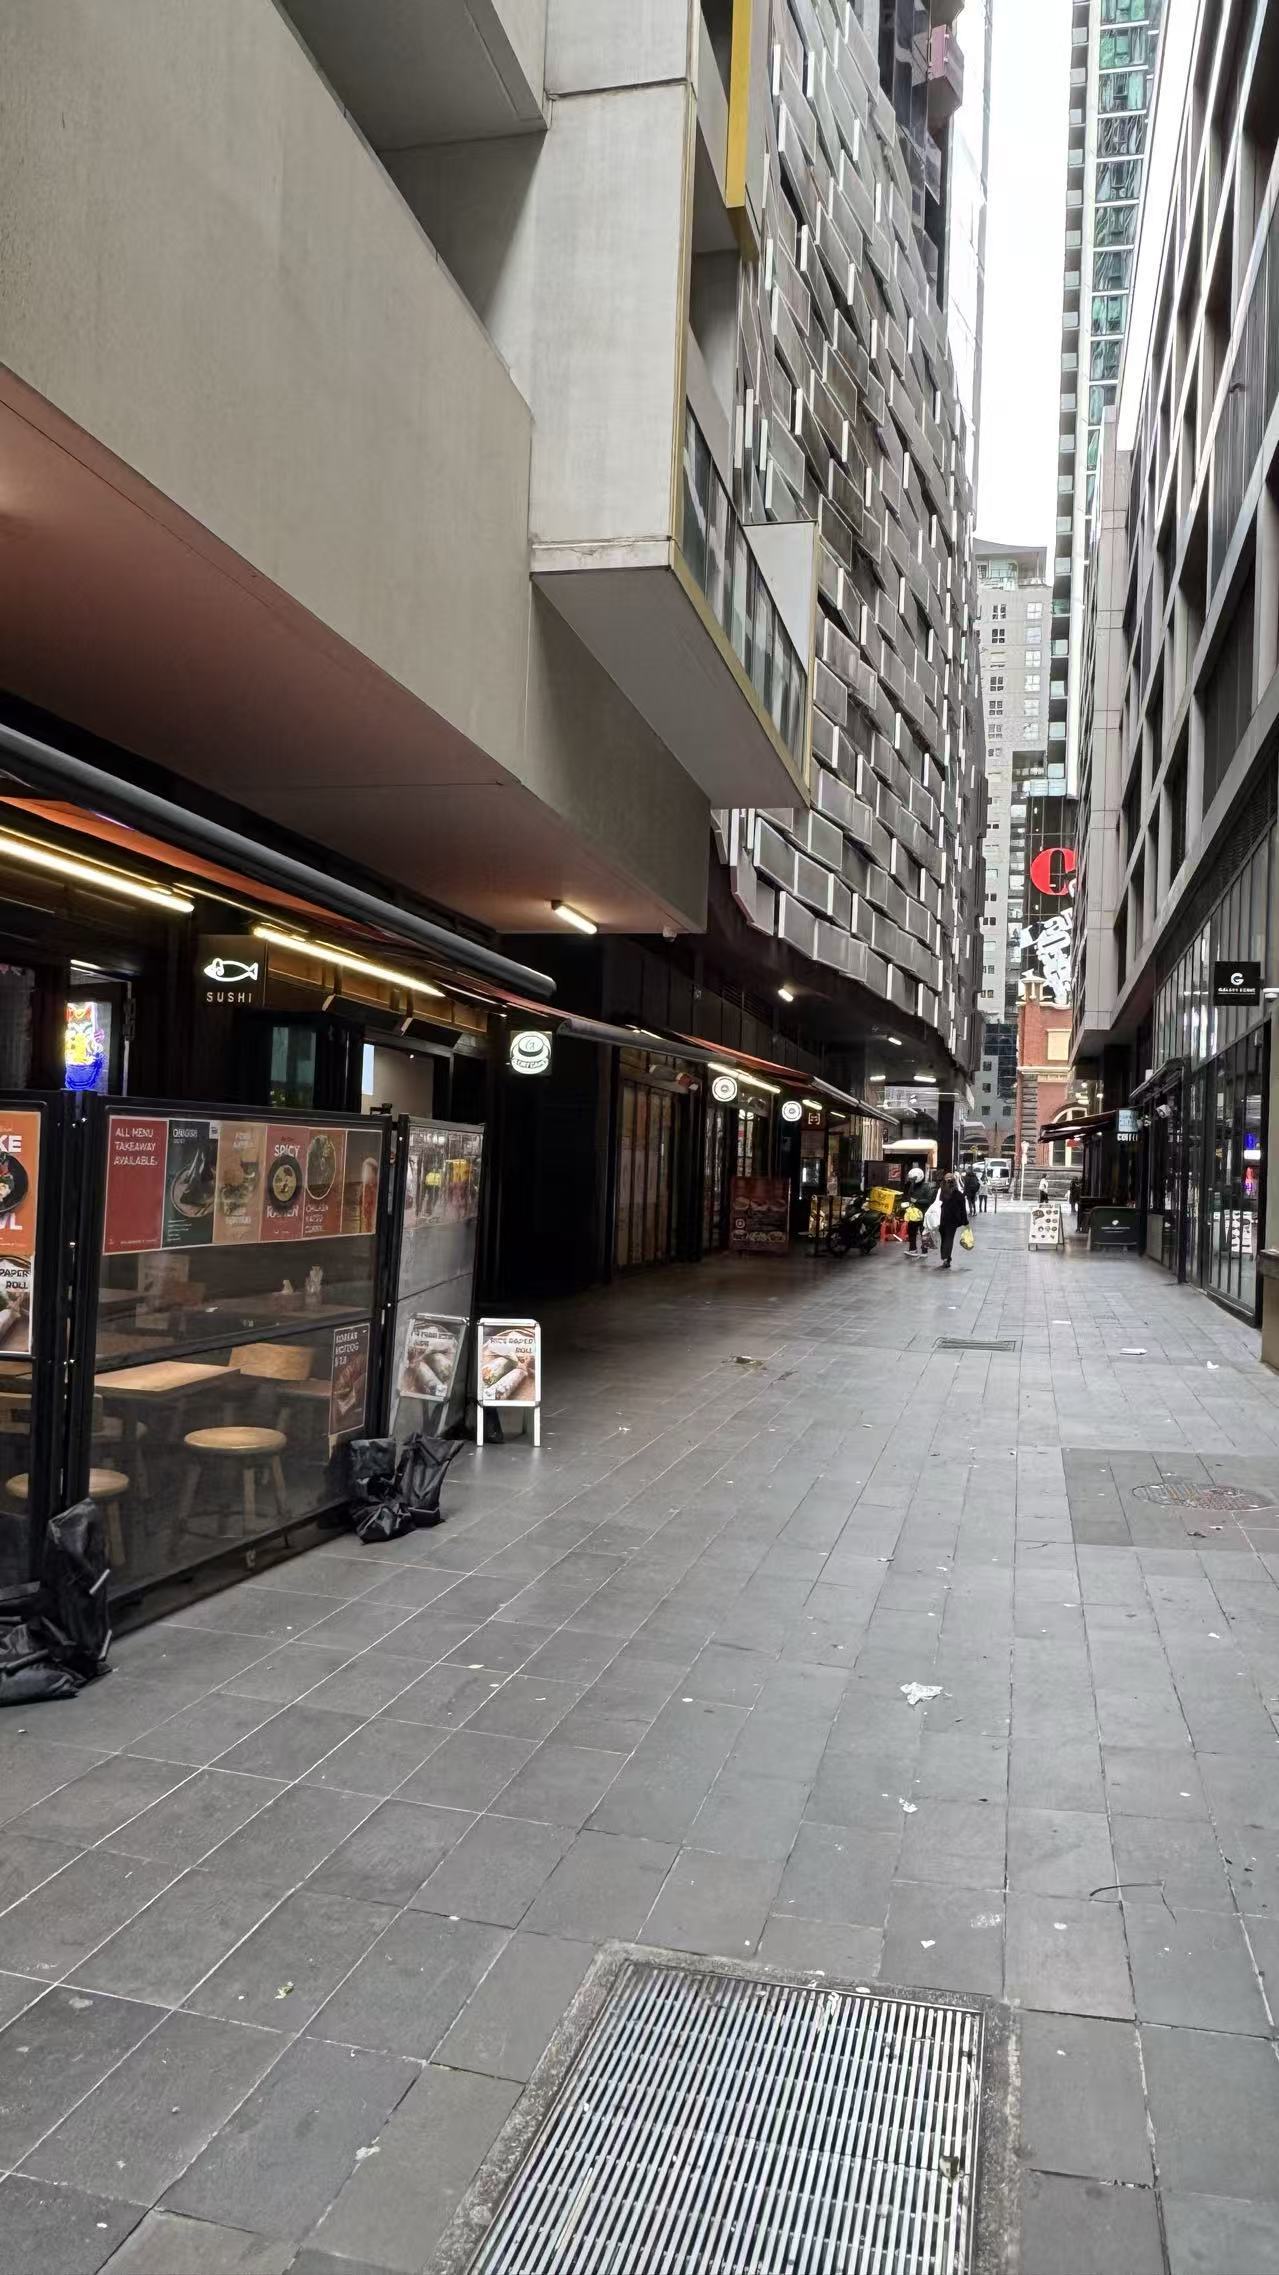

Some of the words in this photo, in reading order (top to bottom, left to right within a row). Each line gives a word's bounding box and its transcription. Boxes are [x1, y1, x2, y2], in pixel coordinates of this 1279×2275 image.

[206, 991, 252, 1003] SUSHI
[115, 1127, 130, 1137] ALL
[132, 1128, 154, 1138] MENU
[114, 1141, 156, 1151] TAKEAWAY
[273, 1144, 300, 1158] SPICY
[0, 1268, 30, 1278] PAPER
[5, 1280, 29, 1289] ROLL
